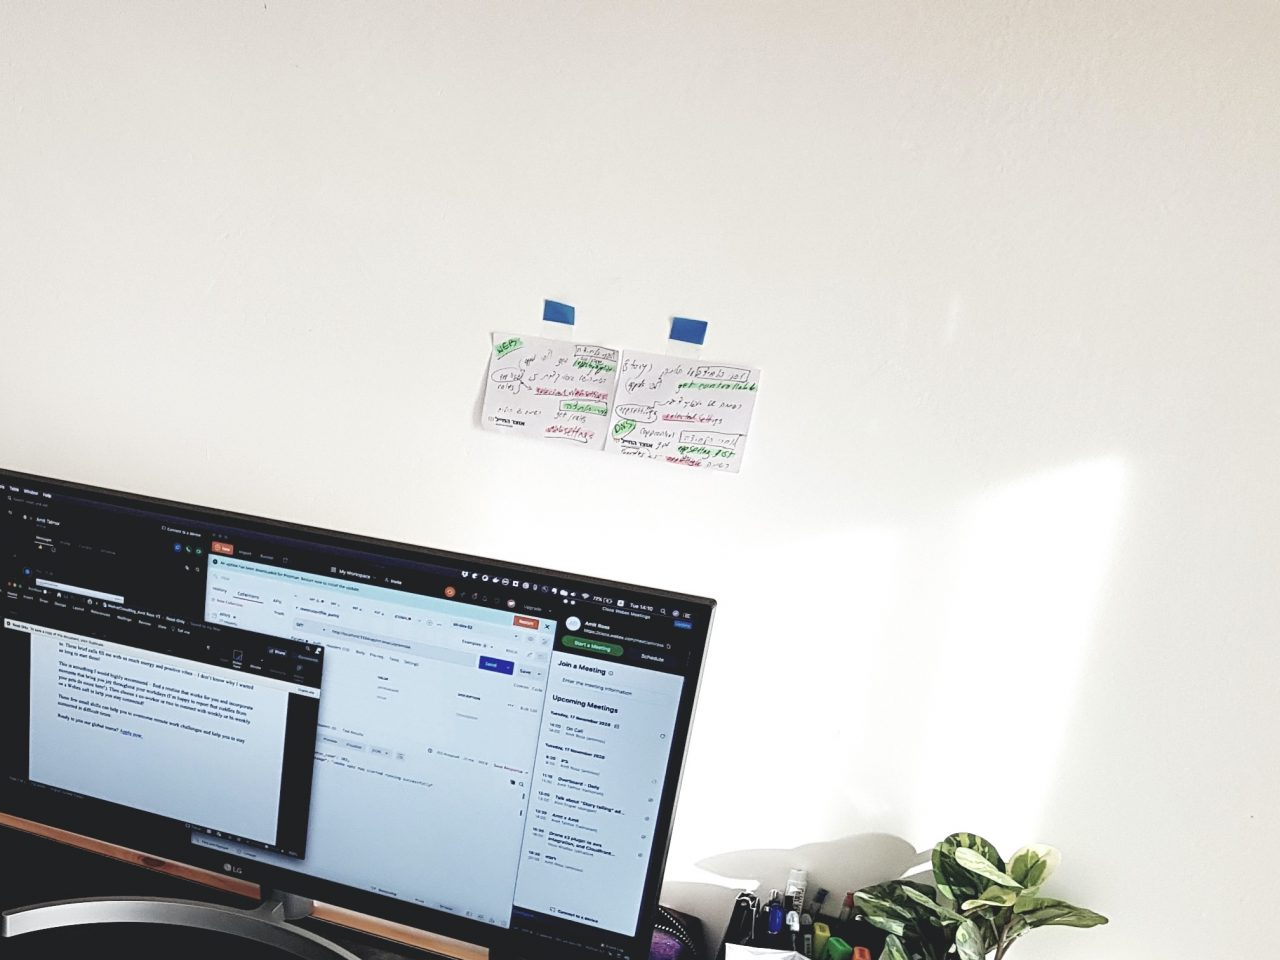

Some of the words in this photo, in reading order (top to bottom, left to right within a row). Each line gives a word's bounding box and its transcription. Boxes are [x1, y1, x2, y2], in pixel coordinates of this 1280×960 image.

[591, 643, 610, 653] Meeting
[640, 652, 664, 662] Schedule
[557, 659, 571, 668] Join
[578, 663, 606, 676] Meeting
[584, 681, 603, 691] meeting
[604, 685, 632, 696] information
[552, 694, 586, 708] Upcoming
[587, 701, 618, 715] Meetings
[232, 866, 242, 874] LG
